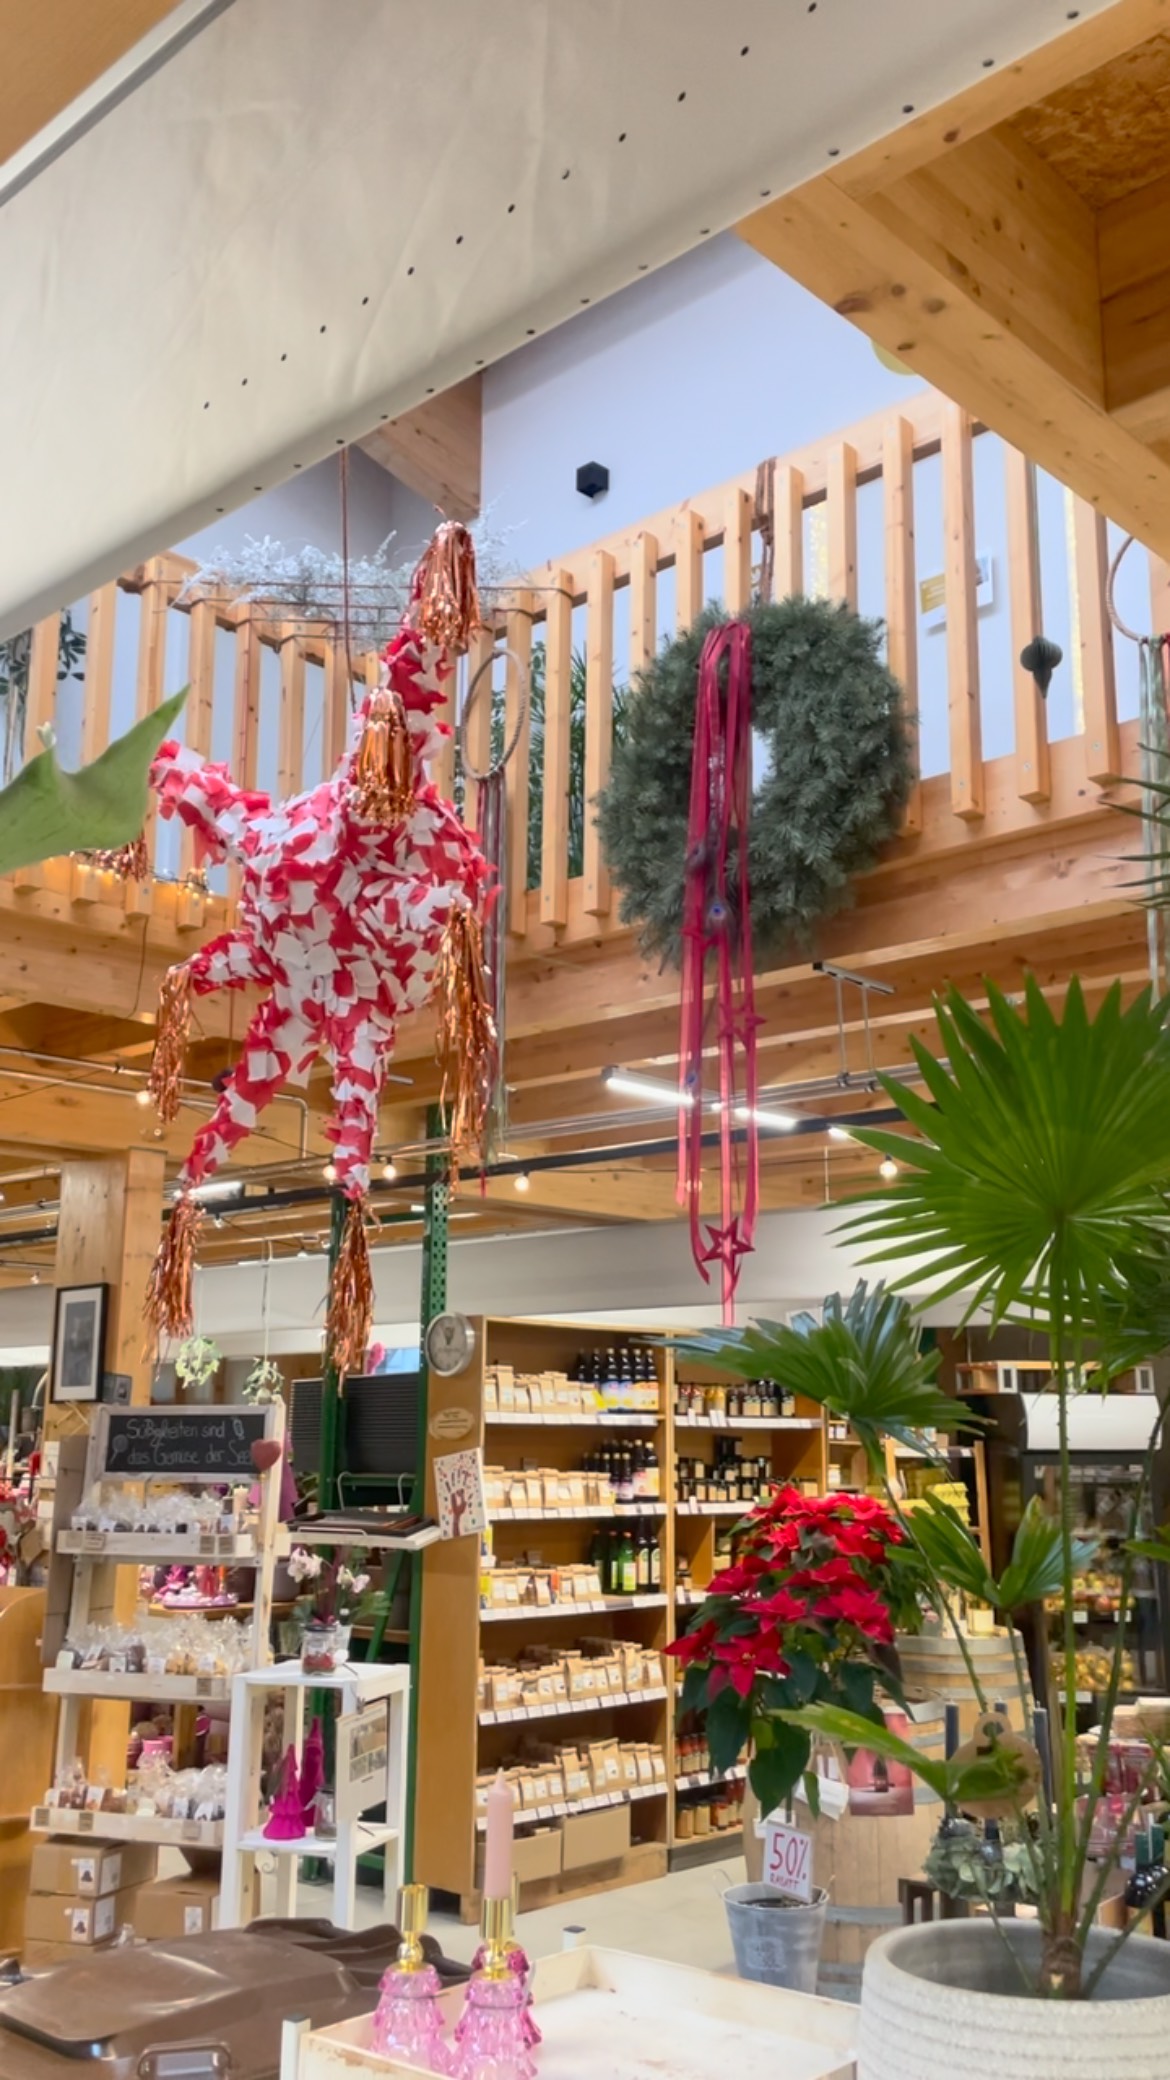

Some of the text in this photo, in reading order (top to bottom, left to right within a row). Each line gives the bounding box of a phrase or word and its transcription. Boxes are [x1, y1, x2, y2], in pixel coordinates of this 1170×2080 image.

[201, 1420, 225, 1438] sind
[127, 1445, 151, 1465] das
[205, 1443, 225, 1464] der
[227, 1439, 252, 1466] See
[769, 1832, 809, 1880] 50%
